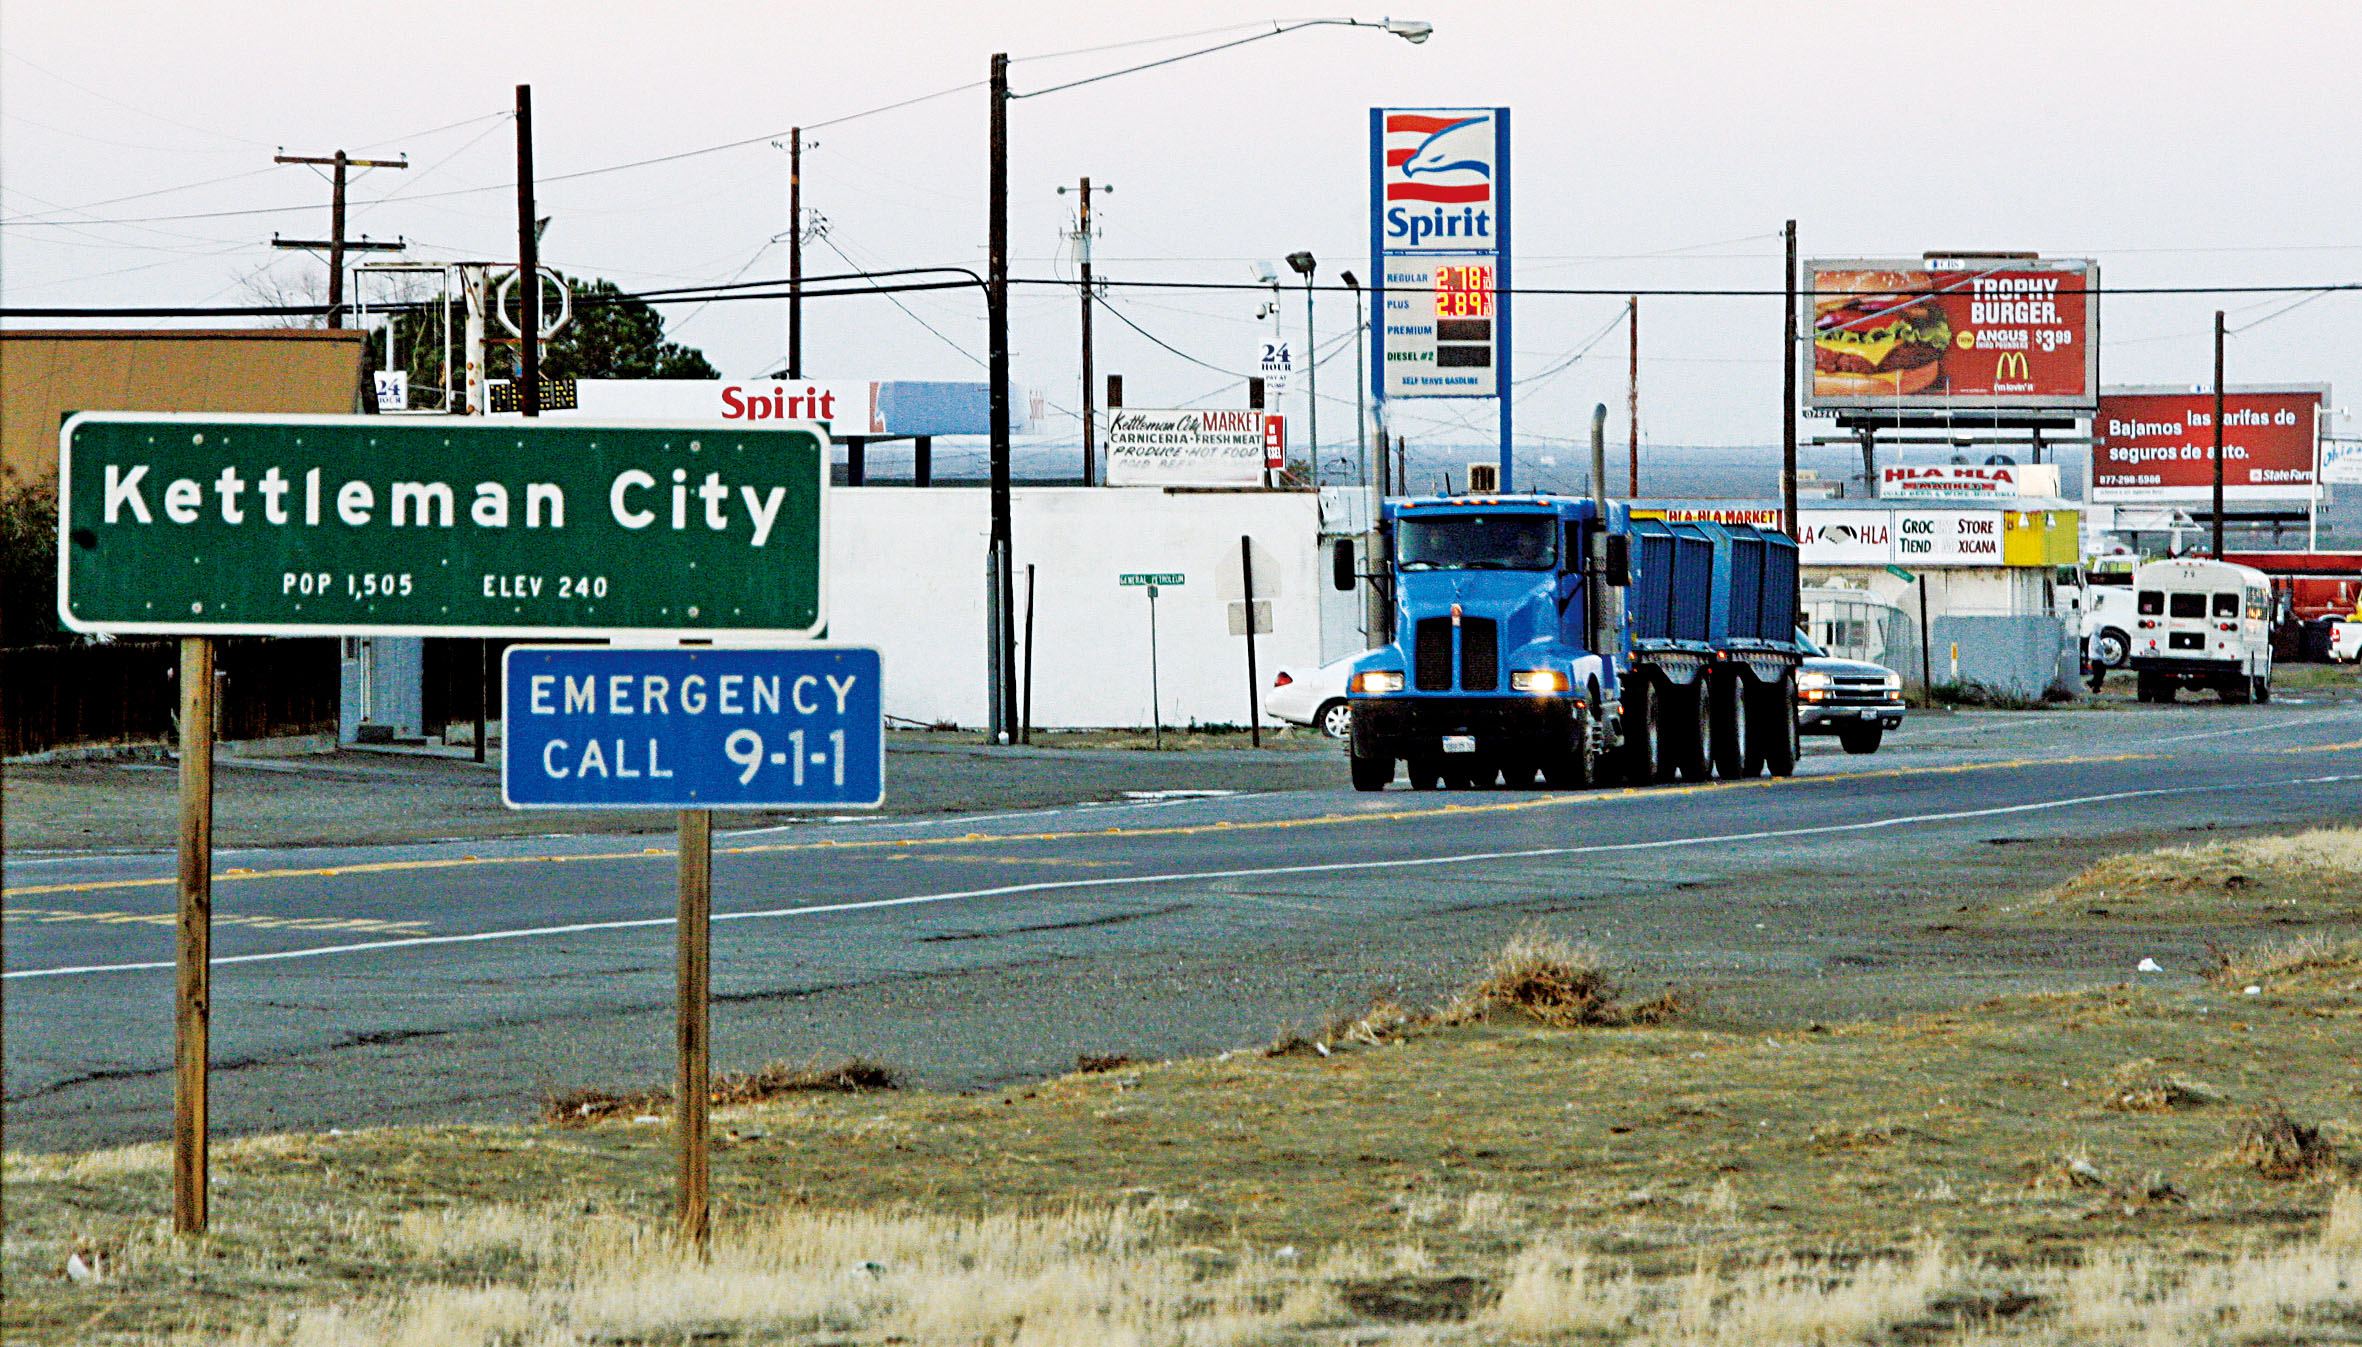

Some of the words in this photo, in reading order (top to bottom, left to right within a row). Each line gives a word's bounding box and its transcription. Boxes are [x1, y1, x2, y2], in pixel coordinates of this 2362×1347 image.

[1387, 206, 1490, 246] Spirit
[1387, 273, 1428, 283] REGULAR
[1973, 278, 2059, 301] TROPHY
[1387, 300, 1410, 309] PLUS
[1971, 302, 2062, 324] BURGER.
[1387, 326, 1432, 335] PREMIUM
[1976, 329, 2028, 342] ANGUS
[1261, 342, 1291, 362] 24
[1387, 351, 1418, 361] DIESEL
[1261, 363, 1291, 371] HOUR
[376, 378, 401, 396] 24
[722, 386, 835, 421] Spirit
[1111, 411, 1175, 433] Kettleman
[1177, 415, 1201, 434] City
[1203, 411, 1262, 432] MARKET
[2187, 409, 2211, 426] las
[2223, 408, 2270, 426] arifas
[2274, 408, 2296, 426] de
[1111, 433, 1188, 444] CARNICERIA
[1195, 434, 1230, 444] FRESH
[1232, 434, 1261, 444] MEAT
[2109, 418, 2183, 440] Bajamos
[1113, 446, 1183, 457] PRODUCE
[2109, 446, 2178, 464] seguros
[2180, 442, 2202, 460] de
[1884, 468, 1944, 483] HLA
[1954, 468, 2015, 484] HLA
[104, 465, 564, 528] Kettleman
[610, 468, 786, 546] City
[1725, 510, 1775, 524] MARKET
[1958, 518, 1994, 534] STORE
[1860, 525, 1888, 545] HLA
[283, 573, 331, 594] POP
[348, 573, 412, 600] 1,505
[483, 575, 542, 597] ELEV
[559, 576, 607, 598] 240
[531, 674, 856, 715] EMERGENCY
[543, 738, 673, 778] CALL
[725, 729, 845, 786] 9-1-1
